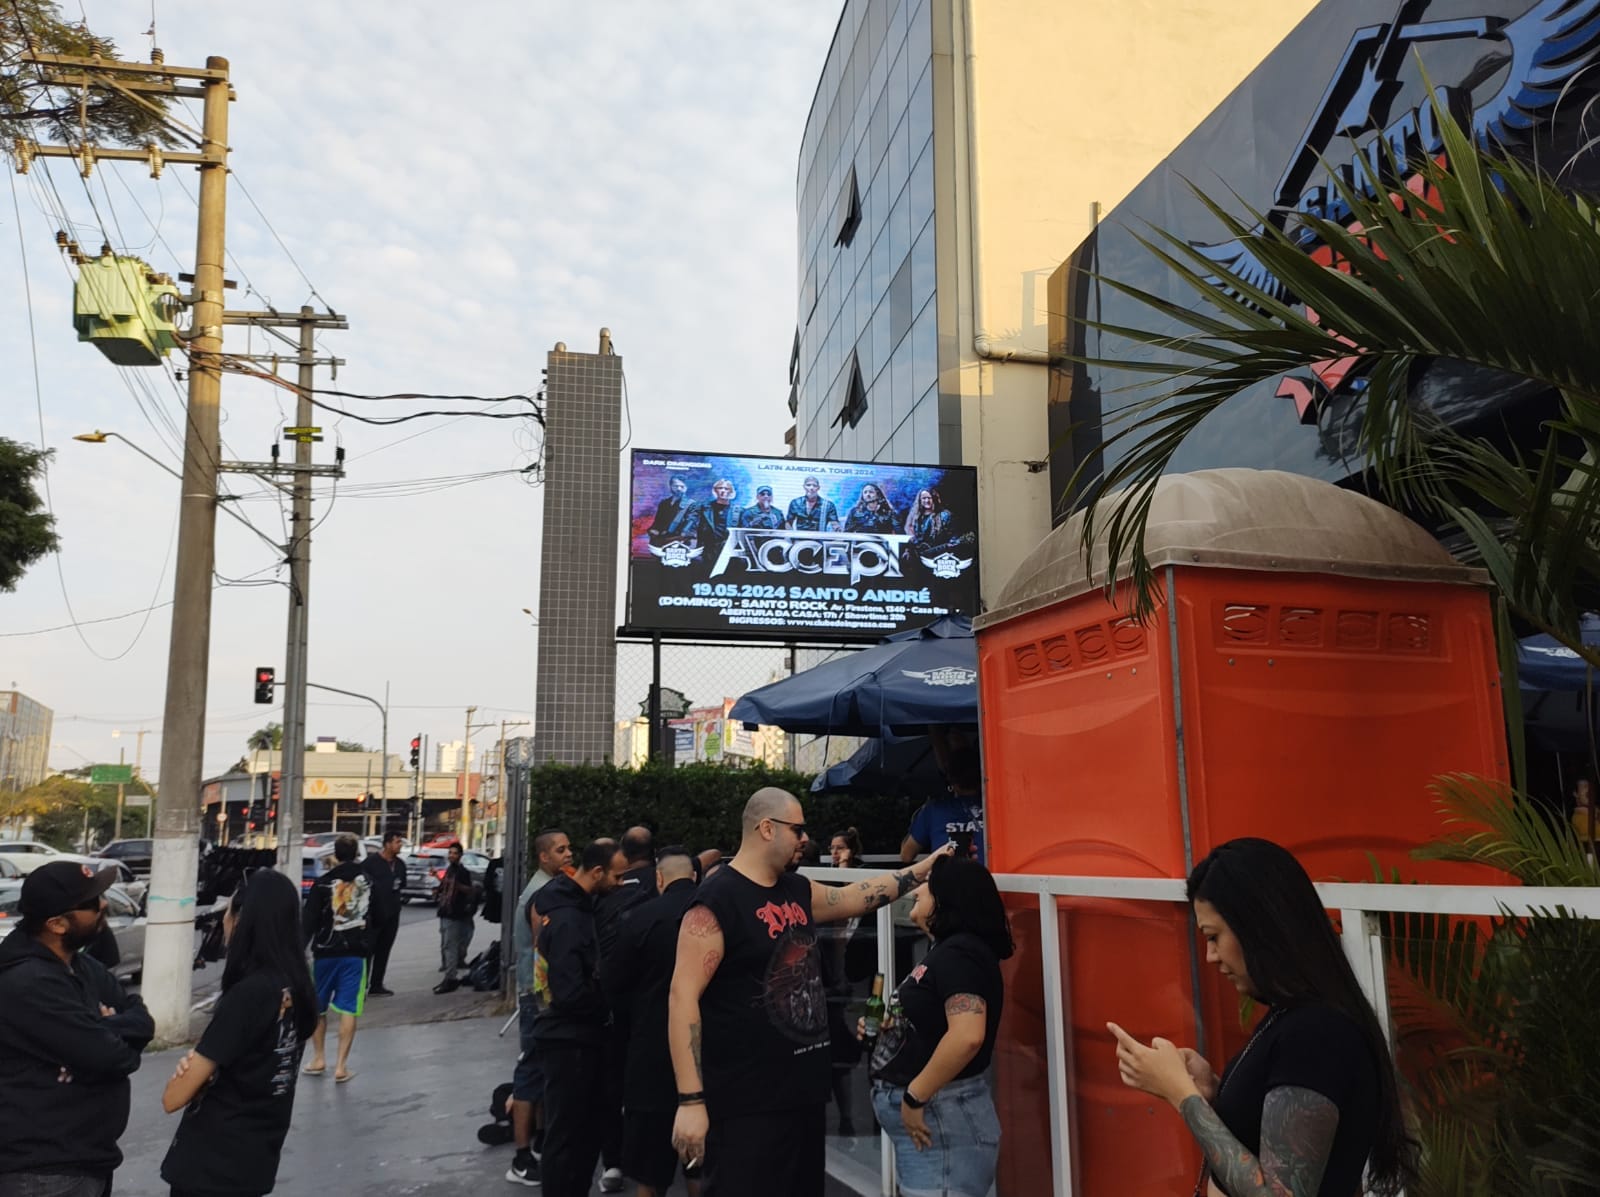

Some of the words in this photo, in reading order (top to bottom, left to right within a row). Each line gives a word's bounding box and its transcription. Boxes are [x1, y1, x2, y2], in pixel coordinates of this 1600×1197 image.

[784, 465, 827, 473] AMERICA
[692, 583, 787, 599] 19.05.2024
[789, 586, 859, 601] SANTO
[861, 587, 931, 604] ANDRÉ
[658, 596, 733, 608] (DOMINGO)
[741, 599, 788, 609] SANTO
[789, 601, 828, 611] ROCK
[718, 608, 774, 617] ABERTURA
[775, 609, 790, 618] DA
[791, 610, 822, 619] CASA:
[755, 899, 808, 939] DIO
